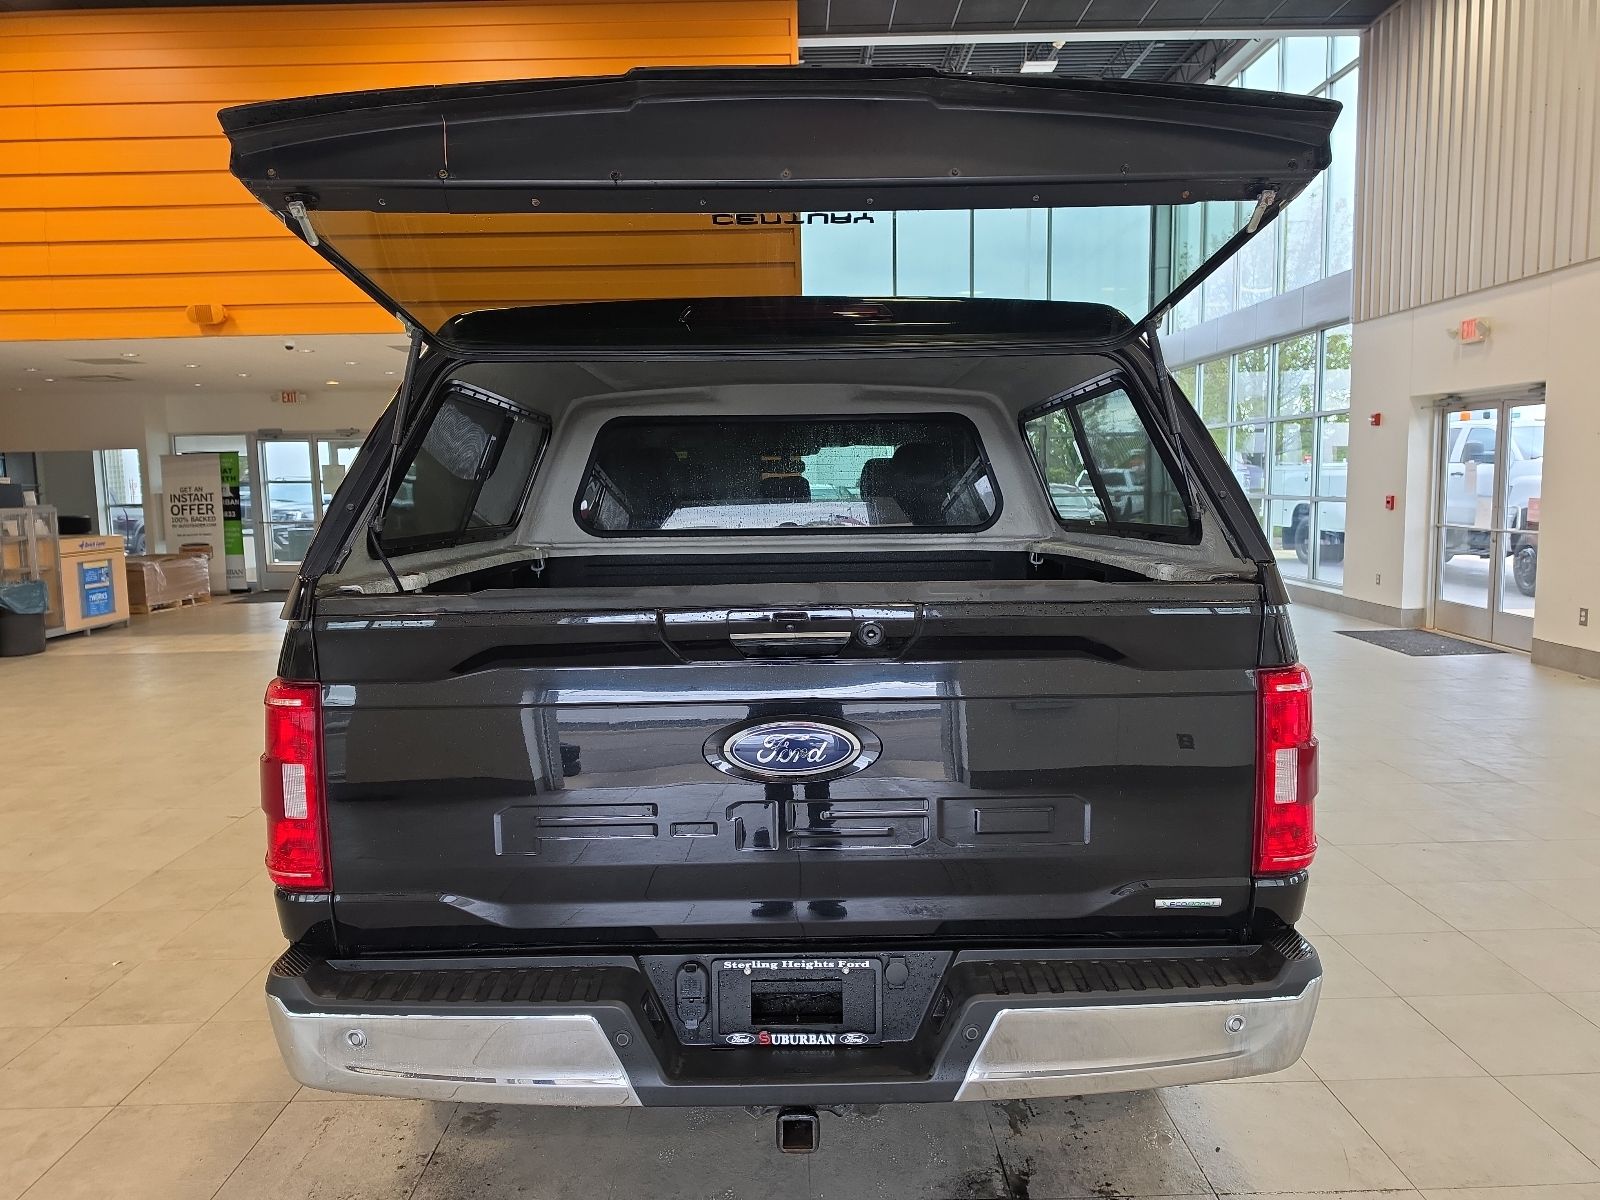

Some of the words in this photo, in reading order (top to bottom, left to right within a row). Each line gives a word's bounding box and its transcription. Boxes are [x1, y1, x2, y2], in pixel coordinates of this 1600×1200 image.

[281, 390, 297, 404] EXIT
[170, 493, 214, 503] INSTANT
[170, 503, 215, 516] OFFER
[190, 515, 217, 523] BACKED
[756, 733, 829, 764] Ford
[723, 960, 779, 971] Sterling
[781, 959, 835, 970] Heights
[837, 959, 871, 969] Ford
[729, 1032, 752, 1044] Ford
[758, 1030, 836, 1045] SUBURBAN
[843, 1032, 866, 1044] Ford
